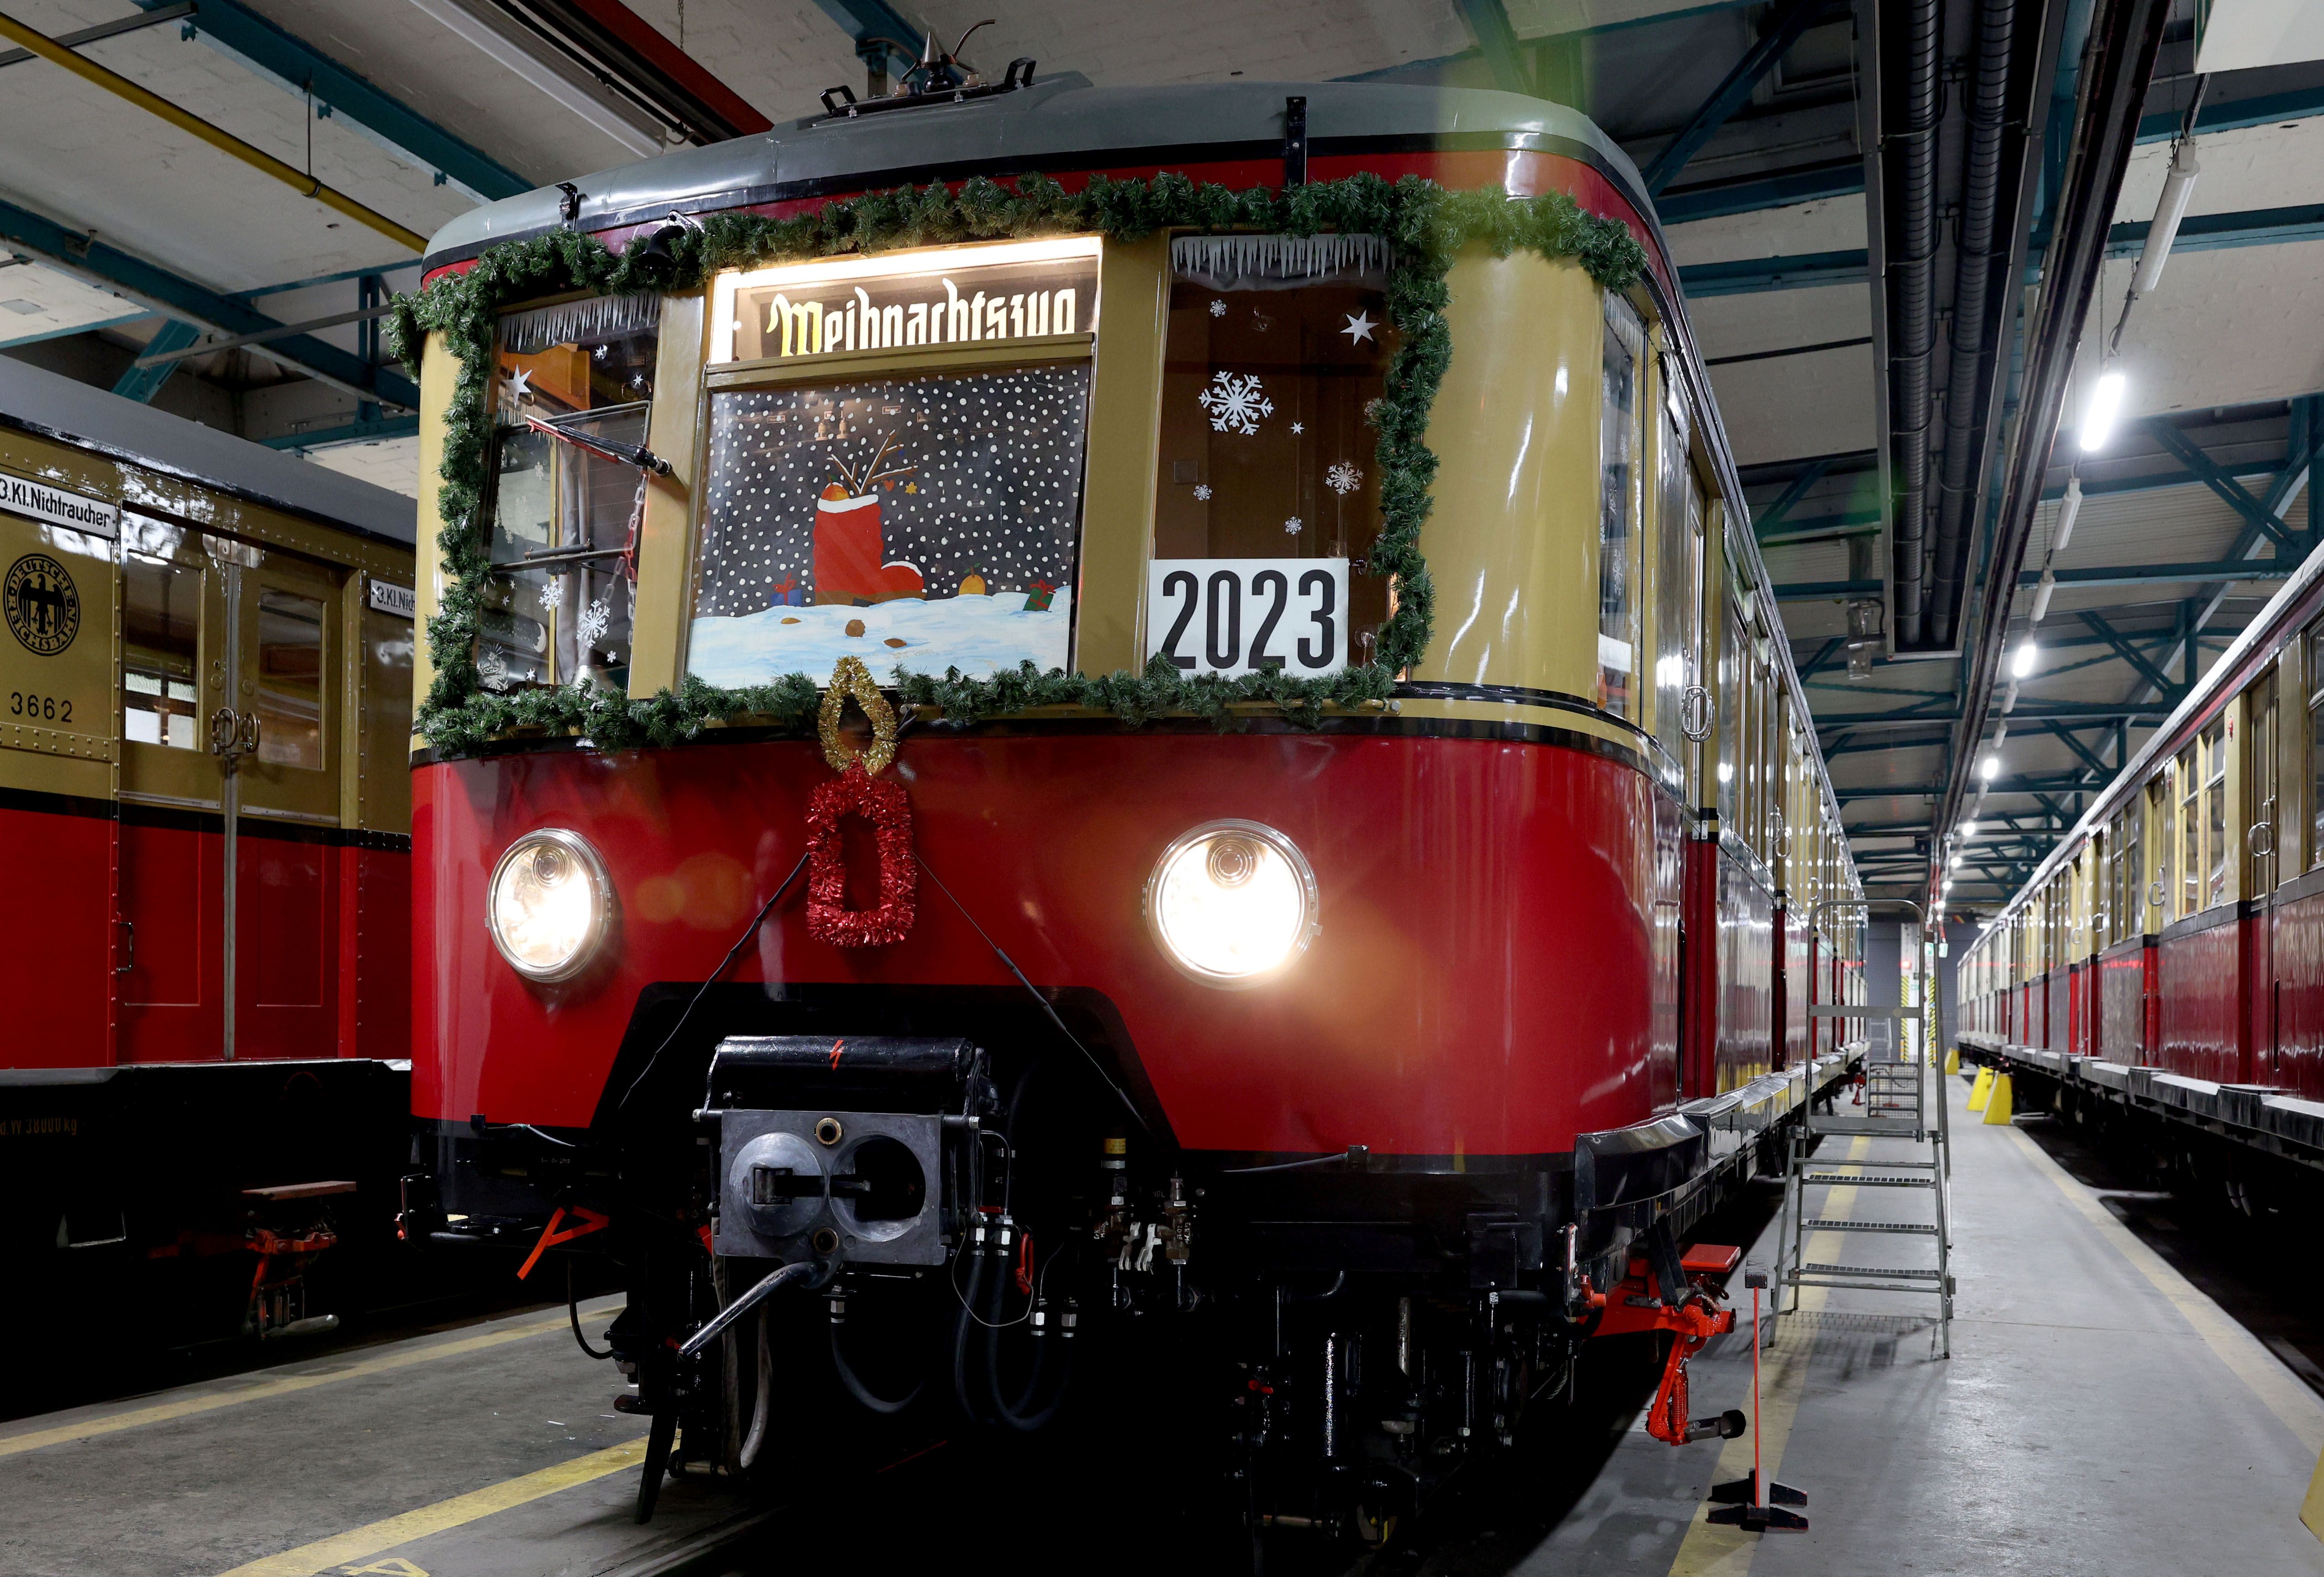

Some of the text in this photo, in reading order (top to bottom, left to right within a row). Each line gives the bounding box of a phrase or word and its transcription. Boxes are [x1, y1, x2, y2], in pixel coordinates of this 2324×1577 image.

[9, 560, 73, 600] DEUTSCHE
[8, 595, 76, 651] REICHSBAHN
[1160, 569, 1335, 669] 2023
[11, 692, 73, 723] 3662
